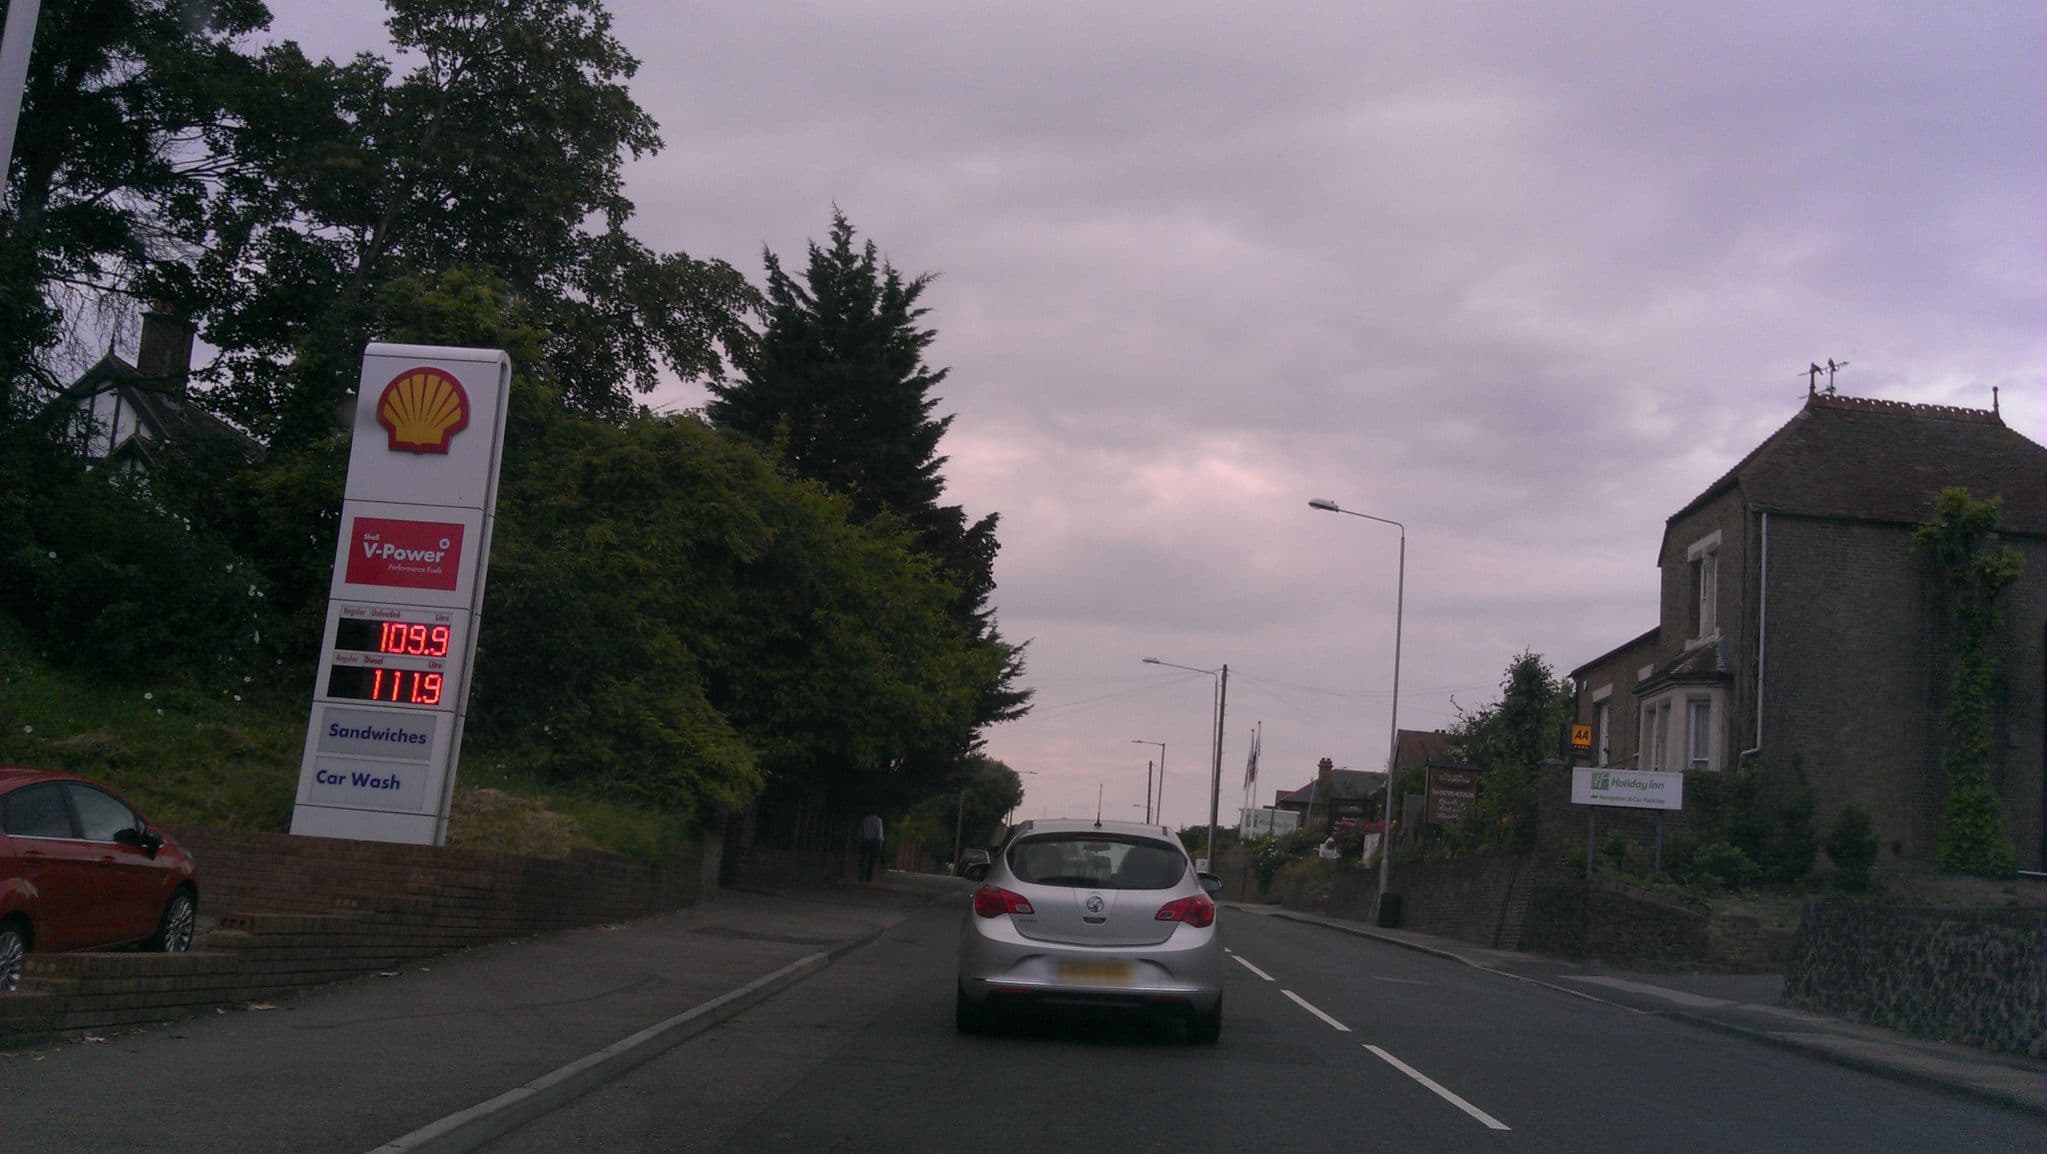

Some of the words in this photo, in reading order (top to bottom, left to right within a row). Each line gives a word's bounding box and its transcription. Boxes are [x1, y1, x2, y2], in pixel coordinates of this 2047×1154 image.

[363, 542, 444, 563] V-Power
[380, 622, 449, 656] 109.9
[372, 669, 441, 704] 111.9
[329, 723, 426, 744] Sandwiches
[1574, 729, 1589, 740] AA
[316, 769, 346, 785] Car
[352, 771, 400, 790] Wash
[1611, 778, 1648, 791] Holiday
[1649, 779, 1664, 790] Inn
